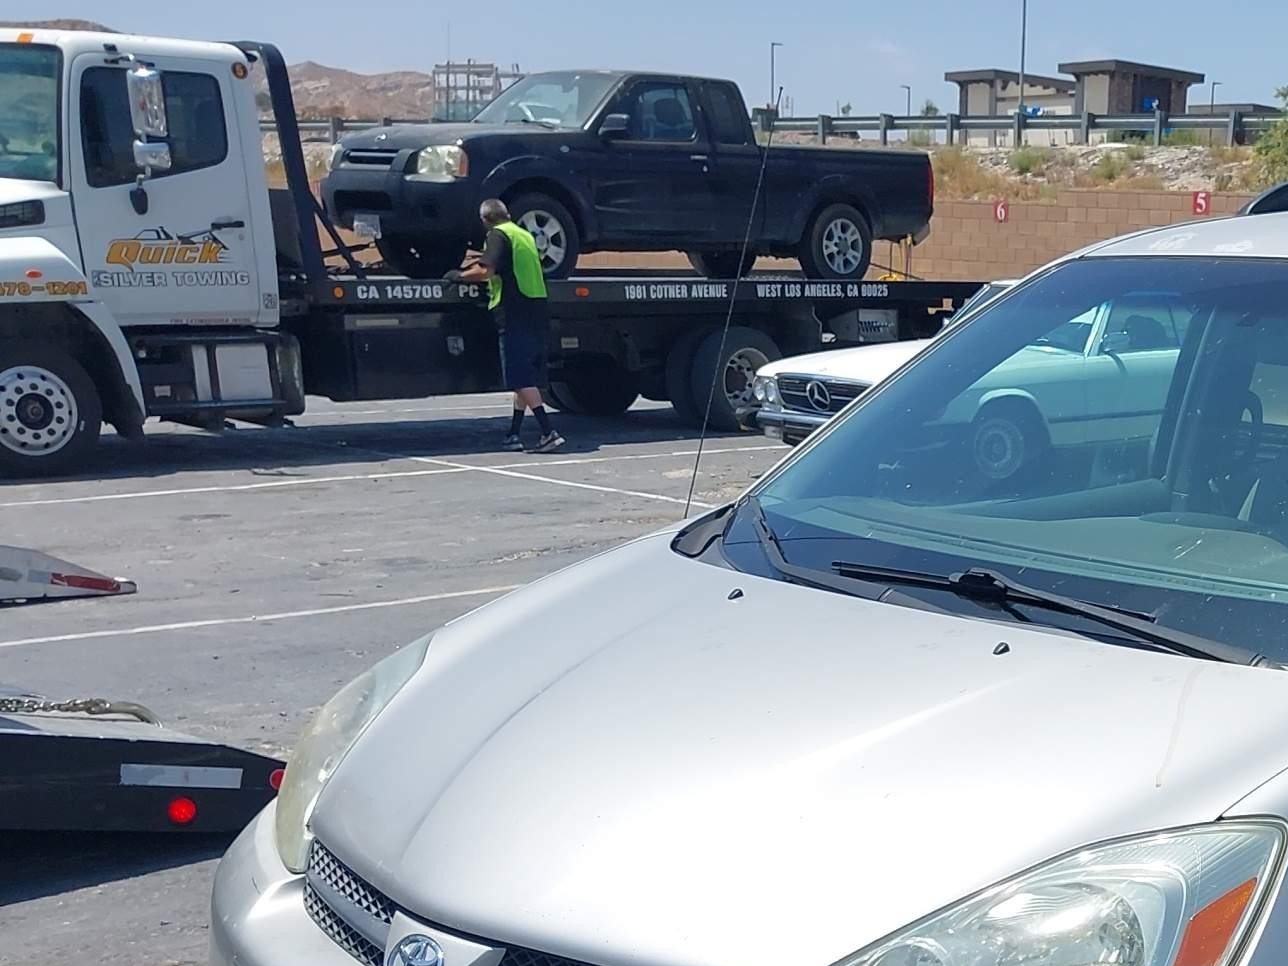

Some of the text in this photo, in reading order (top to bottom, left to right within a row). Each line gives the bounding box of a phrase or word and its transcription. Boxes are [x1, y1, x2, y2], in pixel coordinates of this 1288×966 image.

[996, 202, 1006, 221] 6
[1195, 193, 1207, 213] 5
[106, 238, 225, 273] Quick
[99, 271, 250, 288] SILVER TOWING
[357, 285, 479, 299] CA 145706 PC
[691, 284, 728, 298] AVENUE
[756, 284, 782, 298] WEST
[785, 284, 801, 297] LOS
[804, 284, 845, 299] ANGELES,
[847, 284, 859, 297] CA
